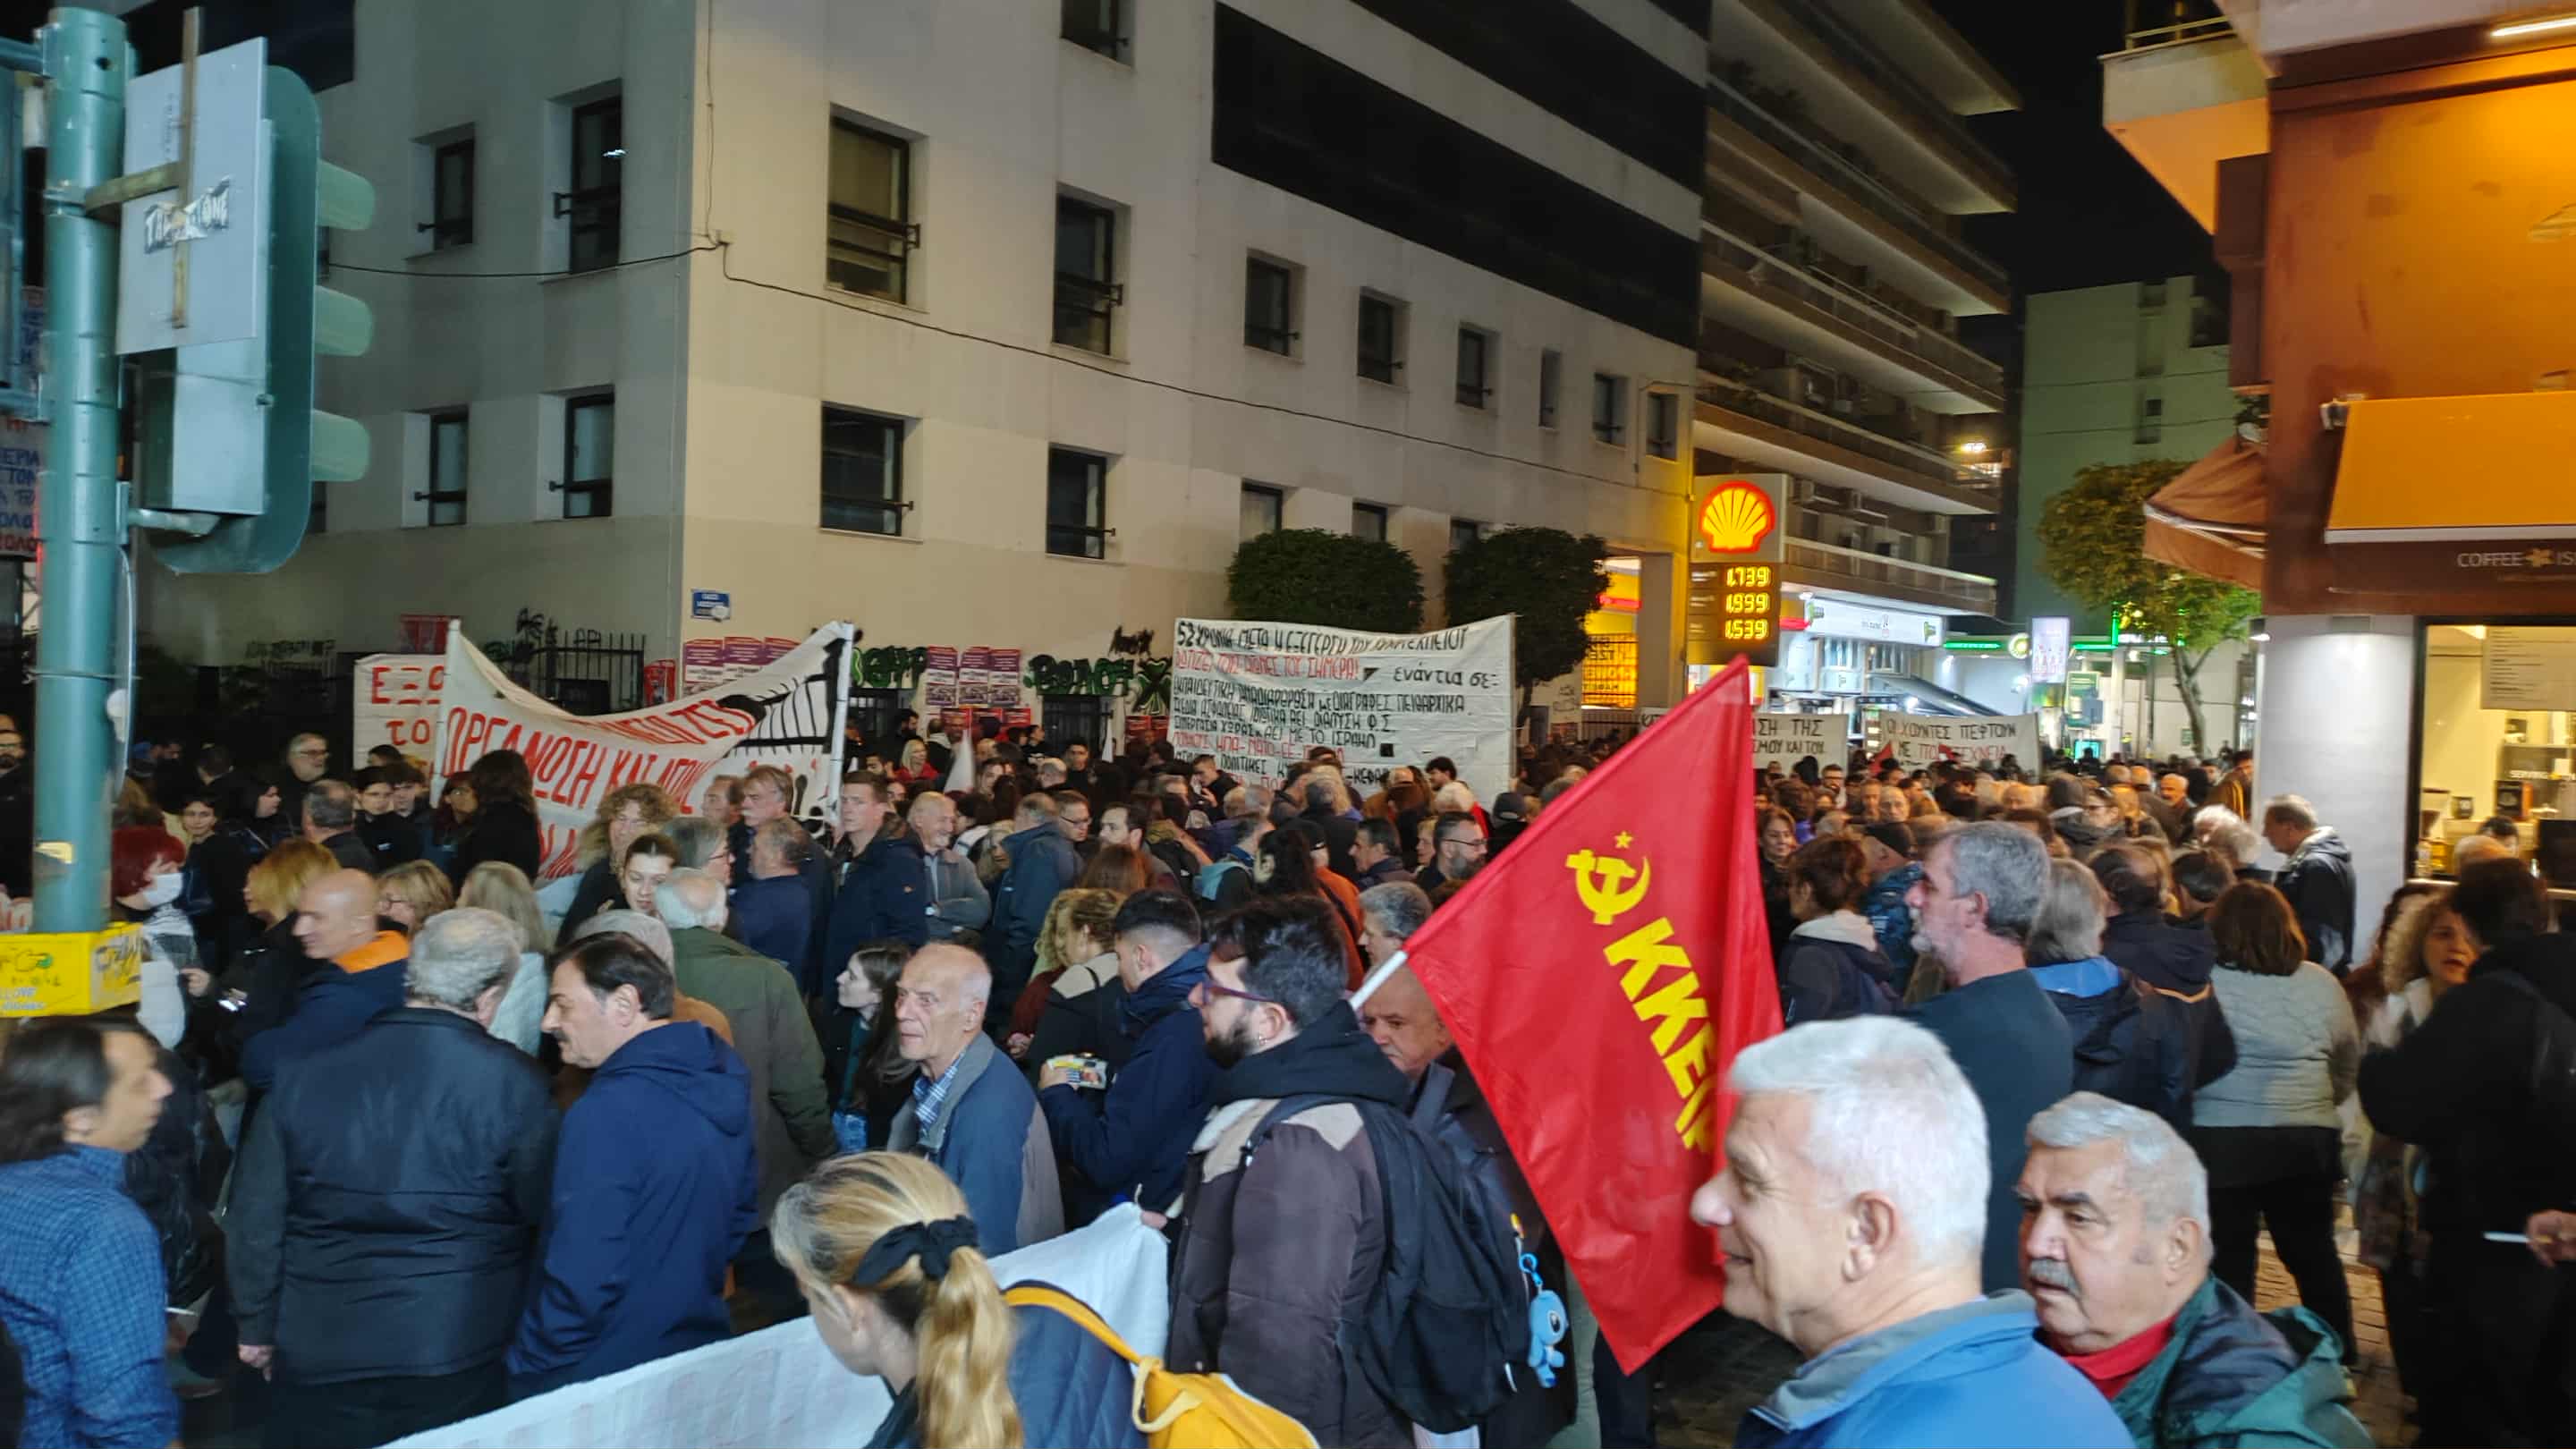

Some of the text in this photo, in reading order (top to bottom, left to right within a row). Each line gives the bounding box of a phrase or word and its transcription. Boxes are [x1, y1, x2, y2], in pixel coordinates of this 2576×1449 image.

[2456, 551, 2576, 567] COFFEE IS
[1726, 566, 1771, 587] 1.739
[1725, 592, 1770, 614] 1.999
[1178, 622, 1195, 647] 52
[1724, 618, 1768, 640] 1.539
[1307, 656, 1360, 680] ΣΗΜΕΡΑ!
[1394, 661, 1463, 686] ενάντια
[1790, 718, 1826, 736] ΤΗΣ
